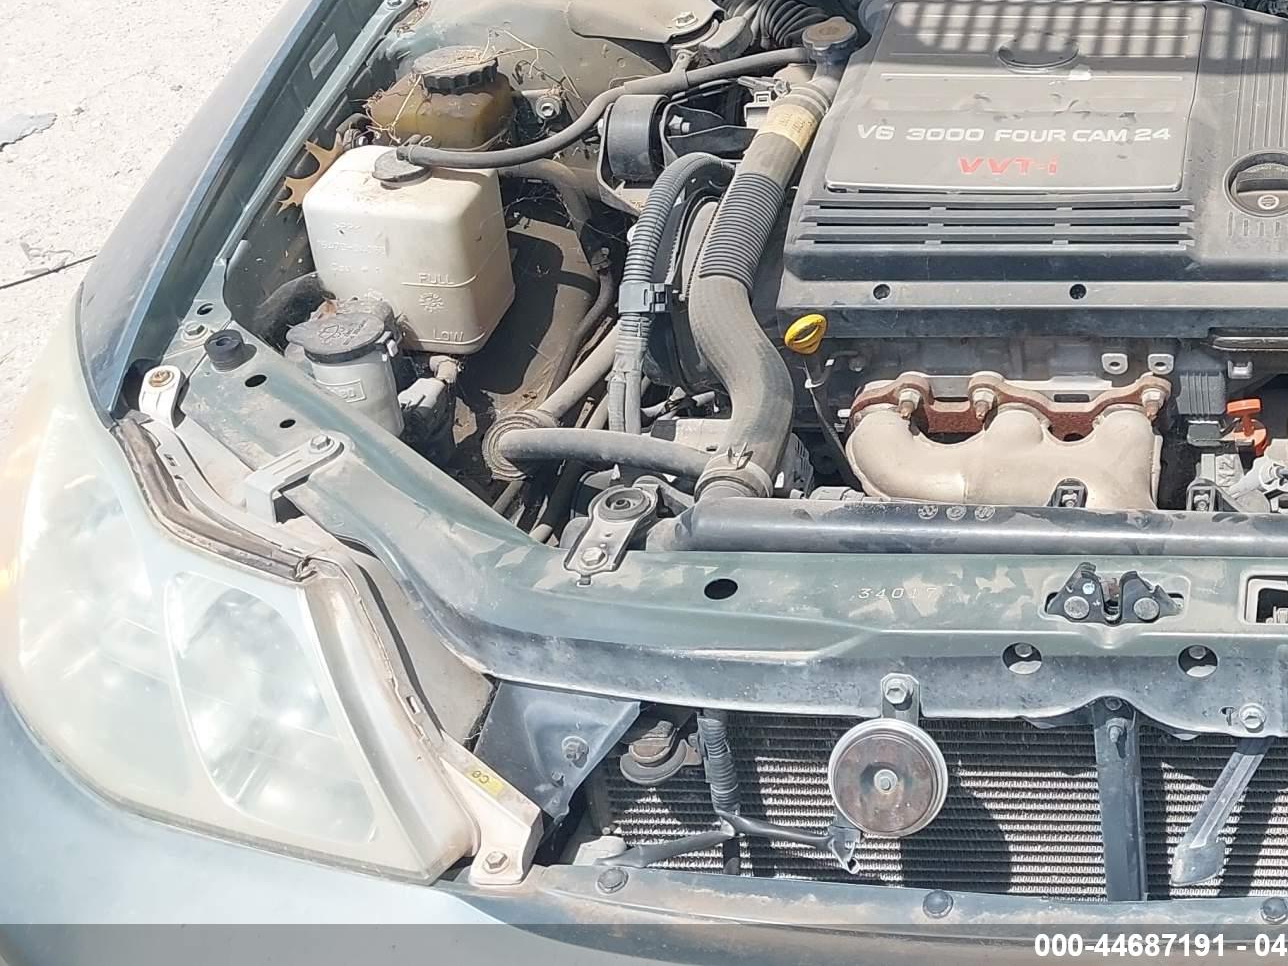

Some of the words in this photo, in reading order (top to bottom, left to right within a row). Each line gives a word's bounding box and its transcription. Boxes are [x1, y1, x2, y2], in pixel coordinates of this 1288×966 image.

[857, 124, 895, 140] V6
[906, 128, 985, 141] 3000
[994, 129, 1067, 143] FOUR
[1072, 129, 1127, 142] CAM
[1134, 128, 1171, 141] 24
[958, 155, 1057, 175] VVT-i
[418, 273, 455, 284] FULL
[434, 330, 465, 342] LOW
